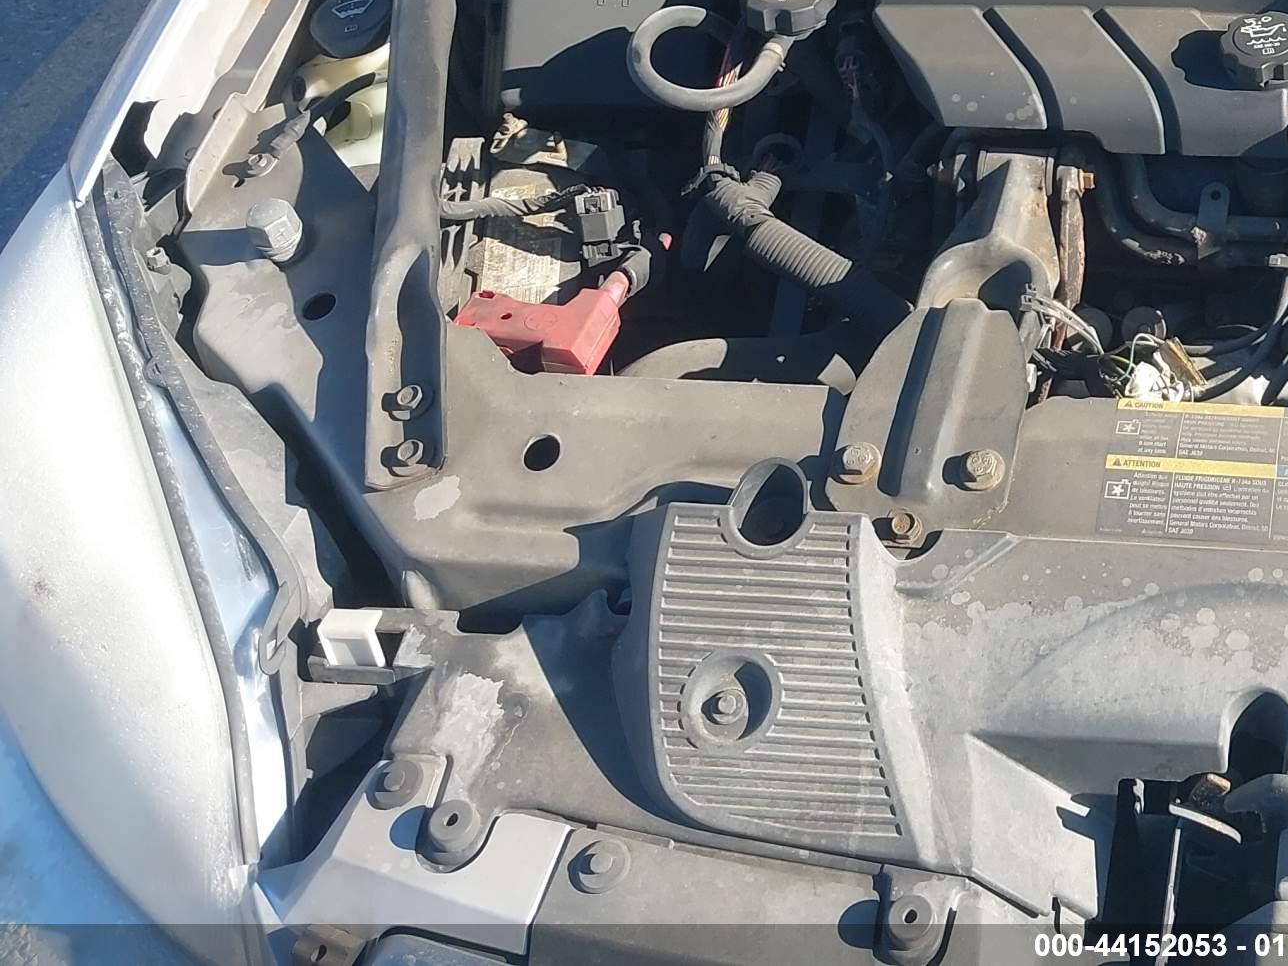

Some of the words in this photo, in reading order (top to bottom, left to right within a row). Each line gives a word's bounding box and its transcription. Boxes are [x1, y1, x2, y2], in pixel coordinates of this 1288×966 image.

[1134, 401, 1164, 409] CAUTION
[1122, 458, 1161, 468] ATTENTION
[1173, 481, 1193, 489] HAUTE
